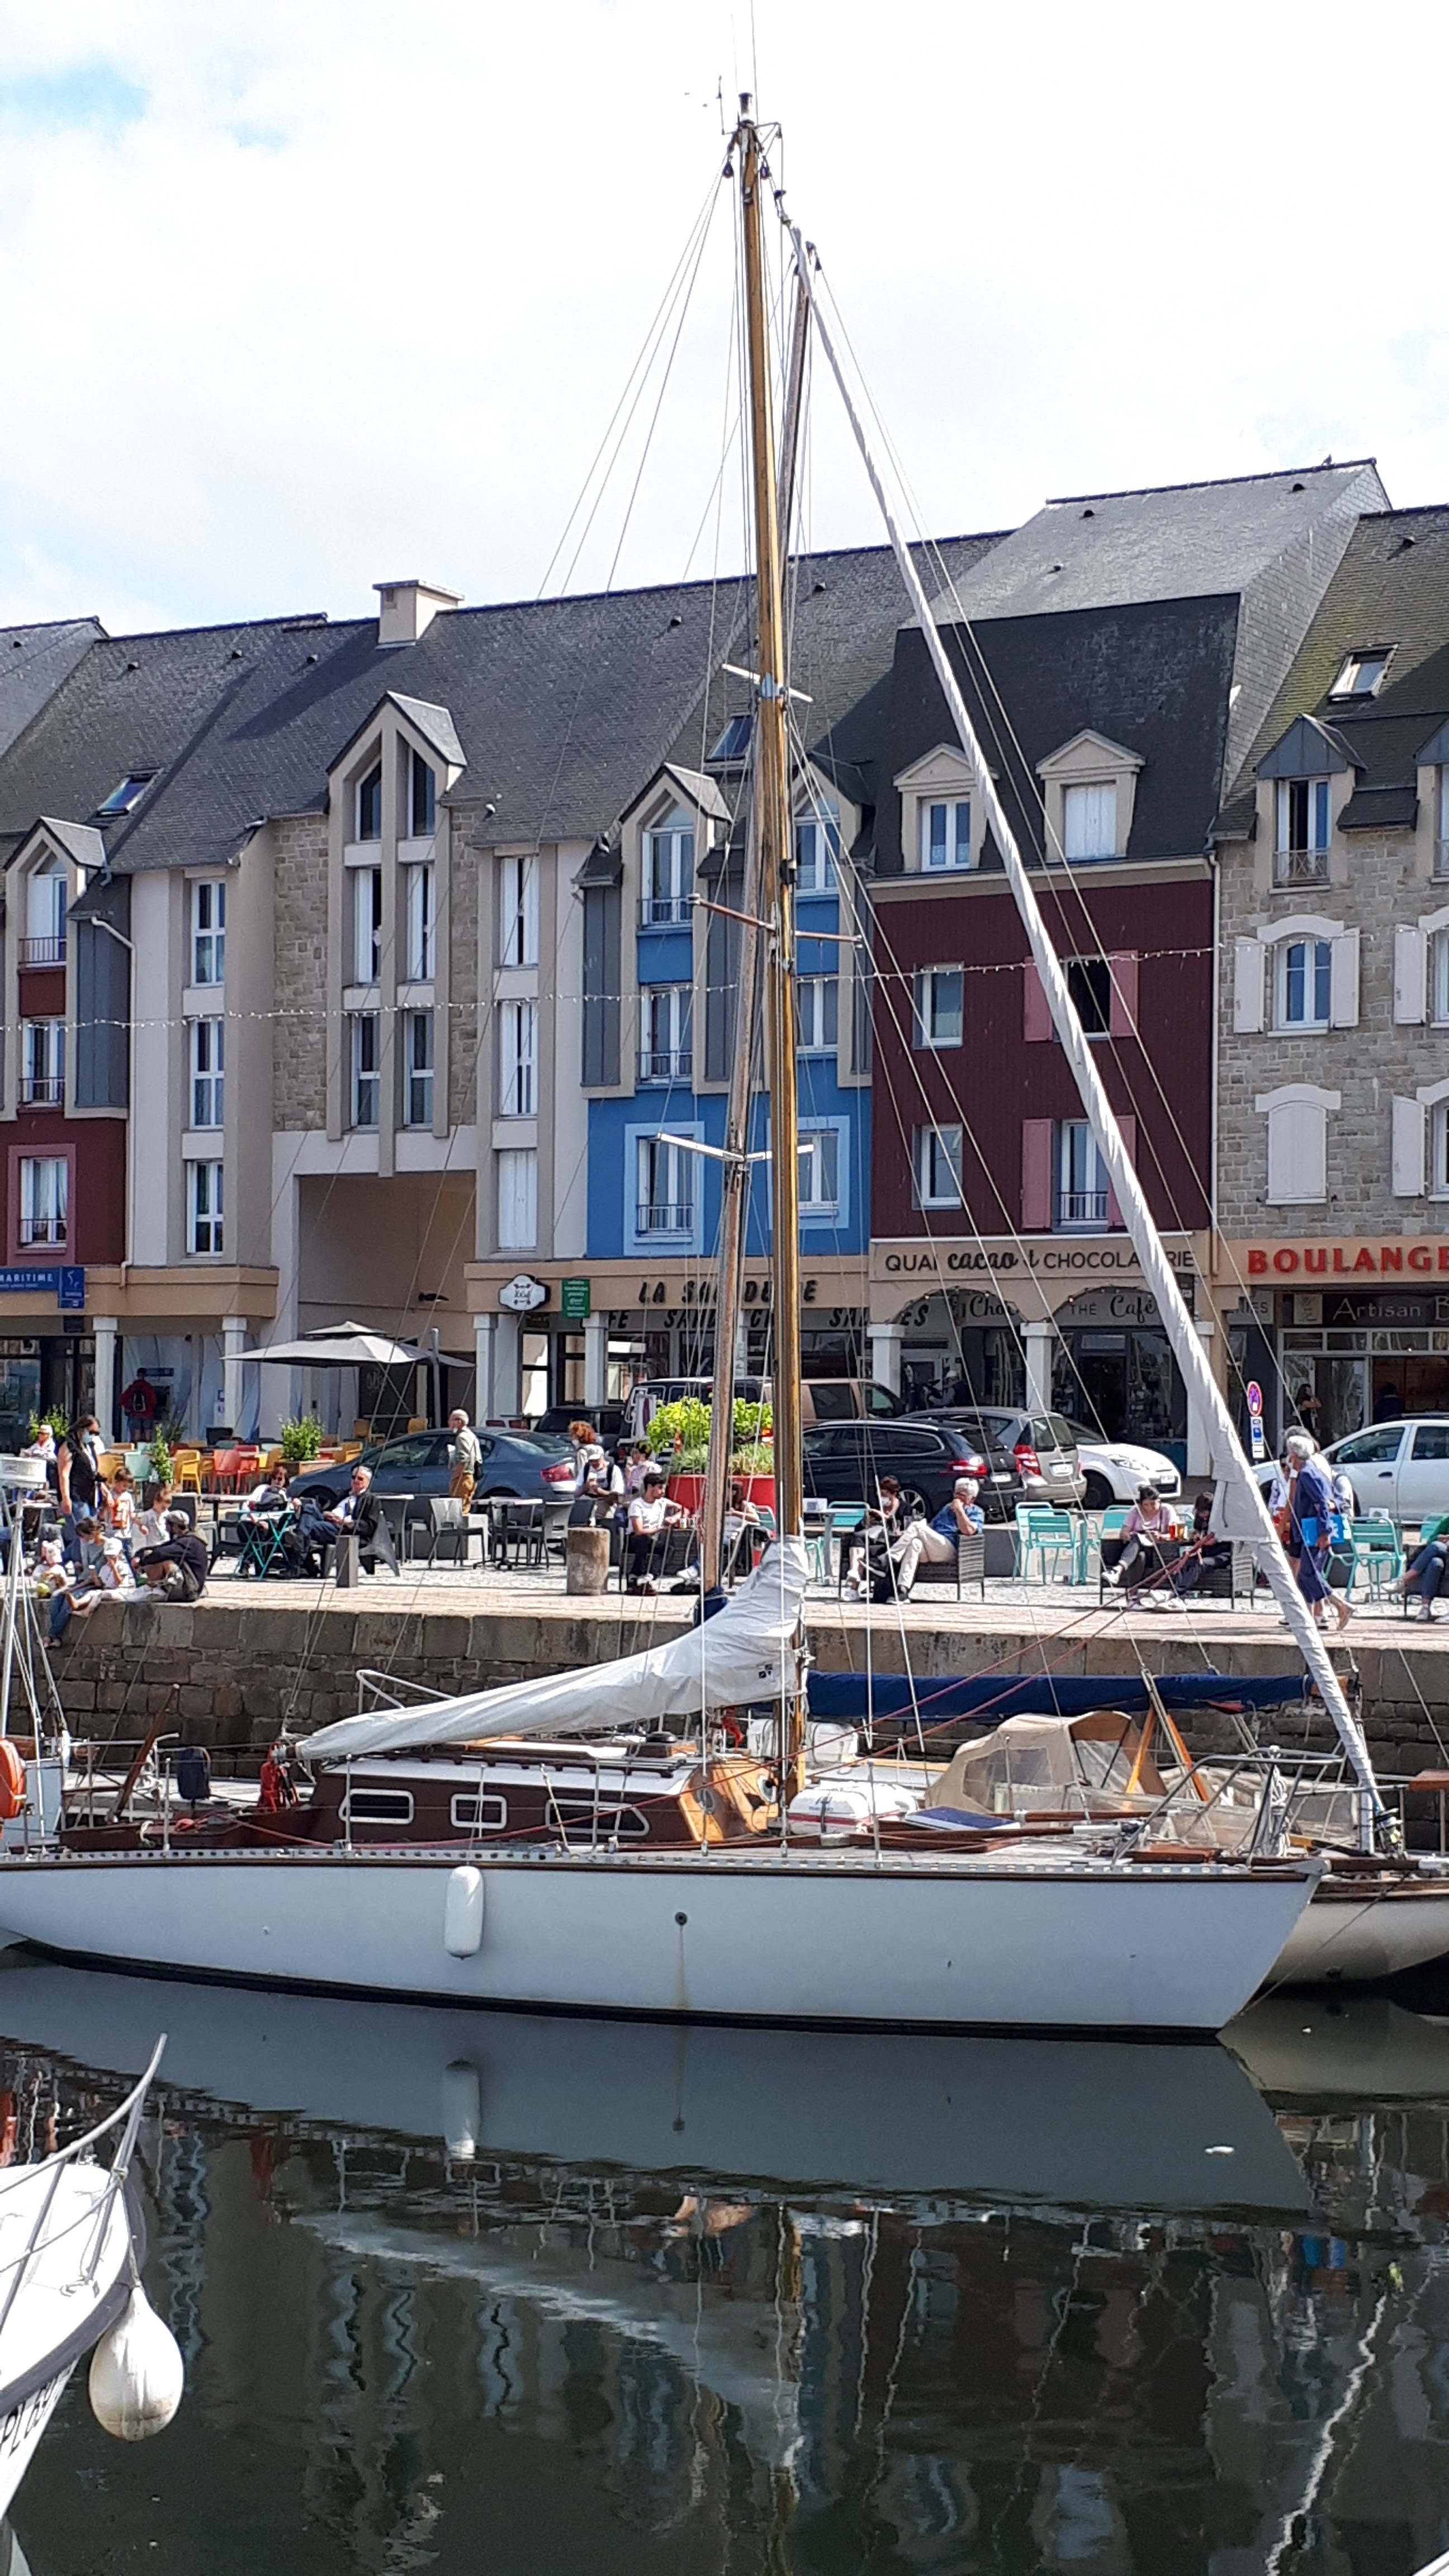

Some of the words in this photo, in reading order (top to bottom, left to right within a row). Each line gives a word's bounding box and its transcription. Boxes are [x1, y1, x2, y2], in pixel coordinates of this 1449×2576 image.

[885, 1254, 939, 1271] QUAI
[948, 1252, 1019, 1270] cacao
[1043, 1250, 1195, 1269] CHOCOLARIE
[1247, 1246, 1449, 1274] BOULANGE
[638, 1281, 666, 1303] LA
[1071, 1303, 1097, 1315] THÉ
[1110, 1295, 1157, 1323] Café
[1333, 1298, 1420, 1320] Artisan
